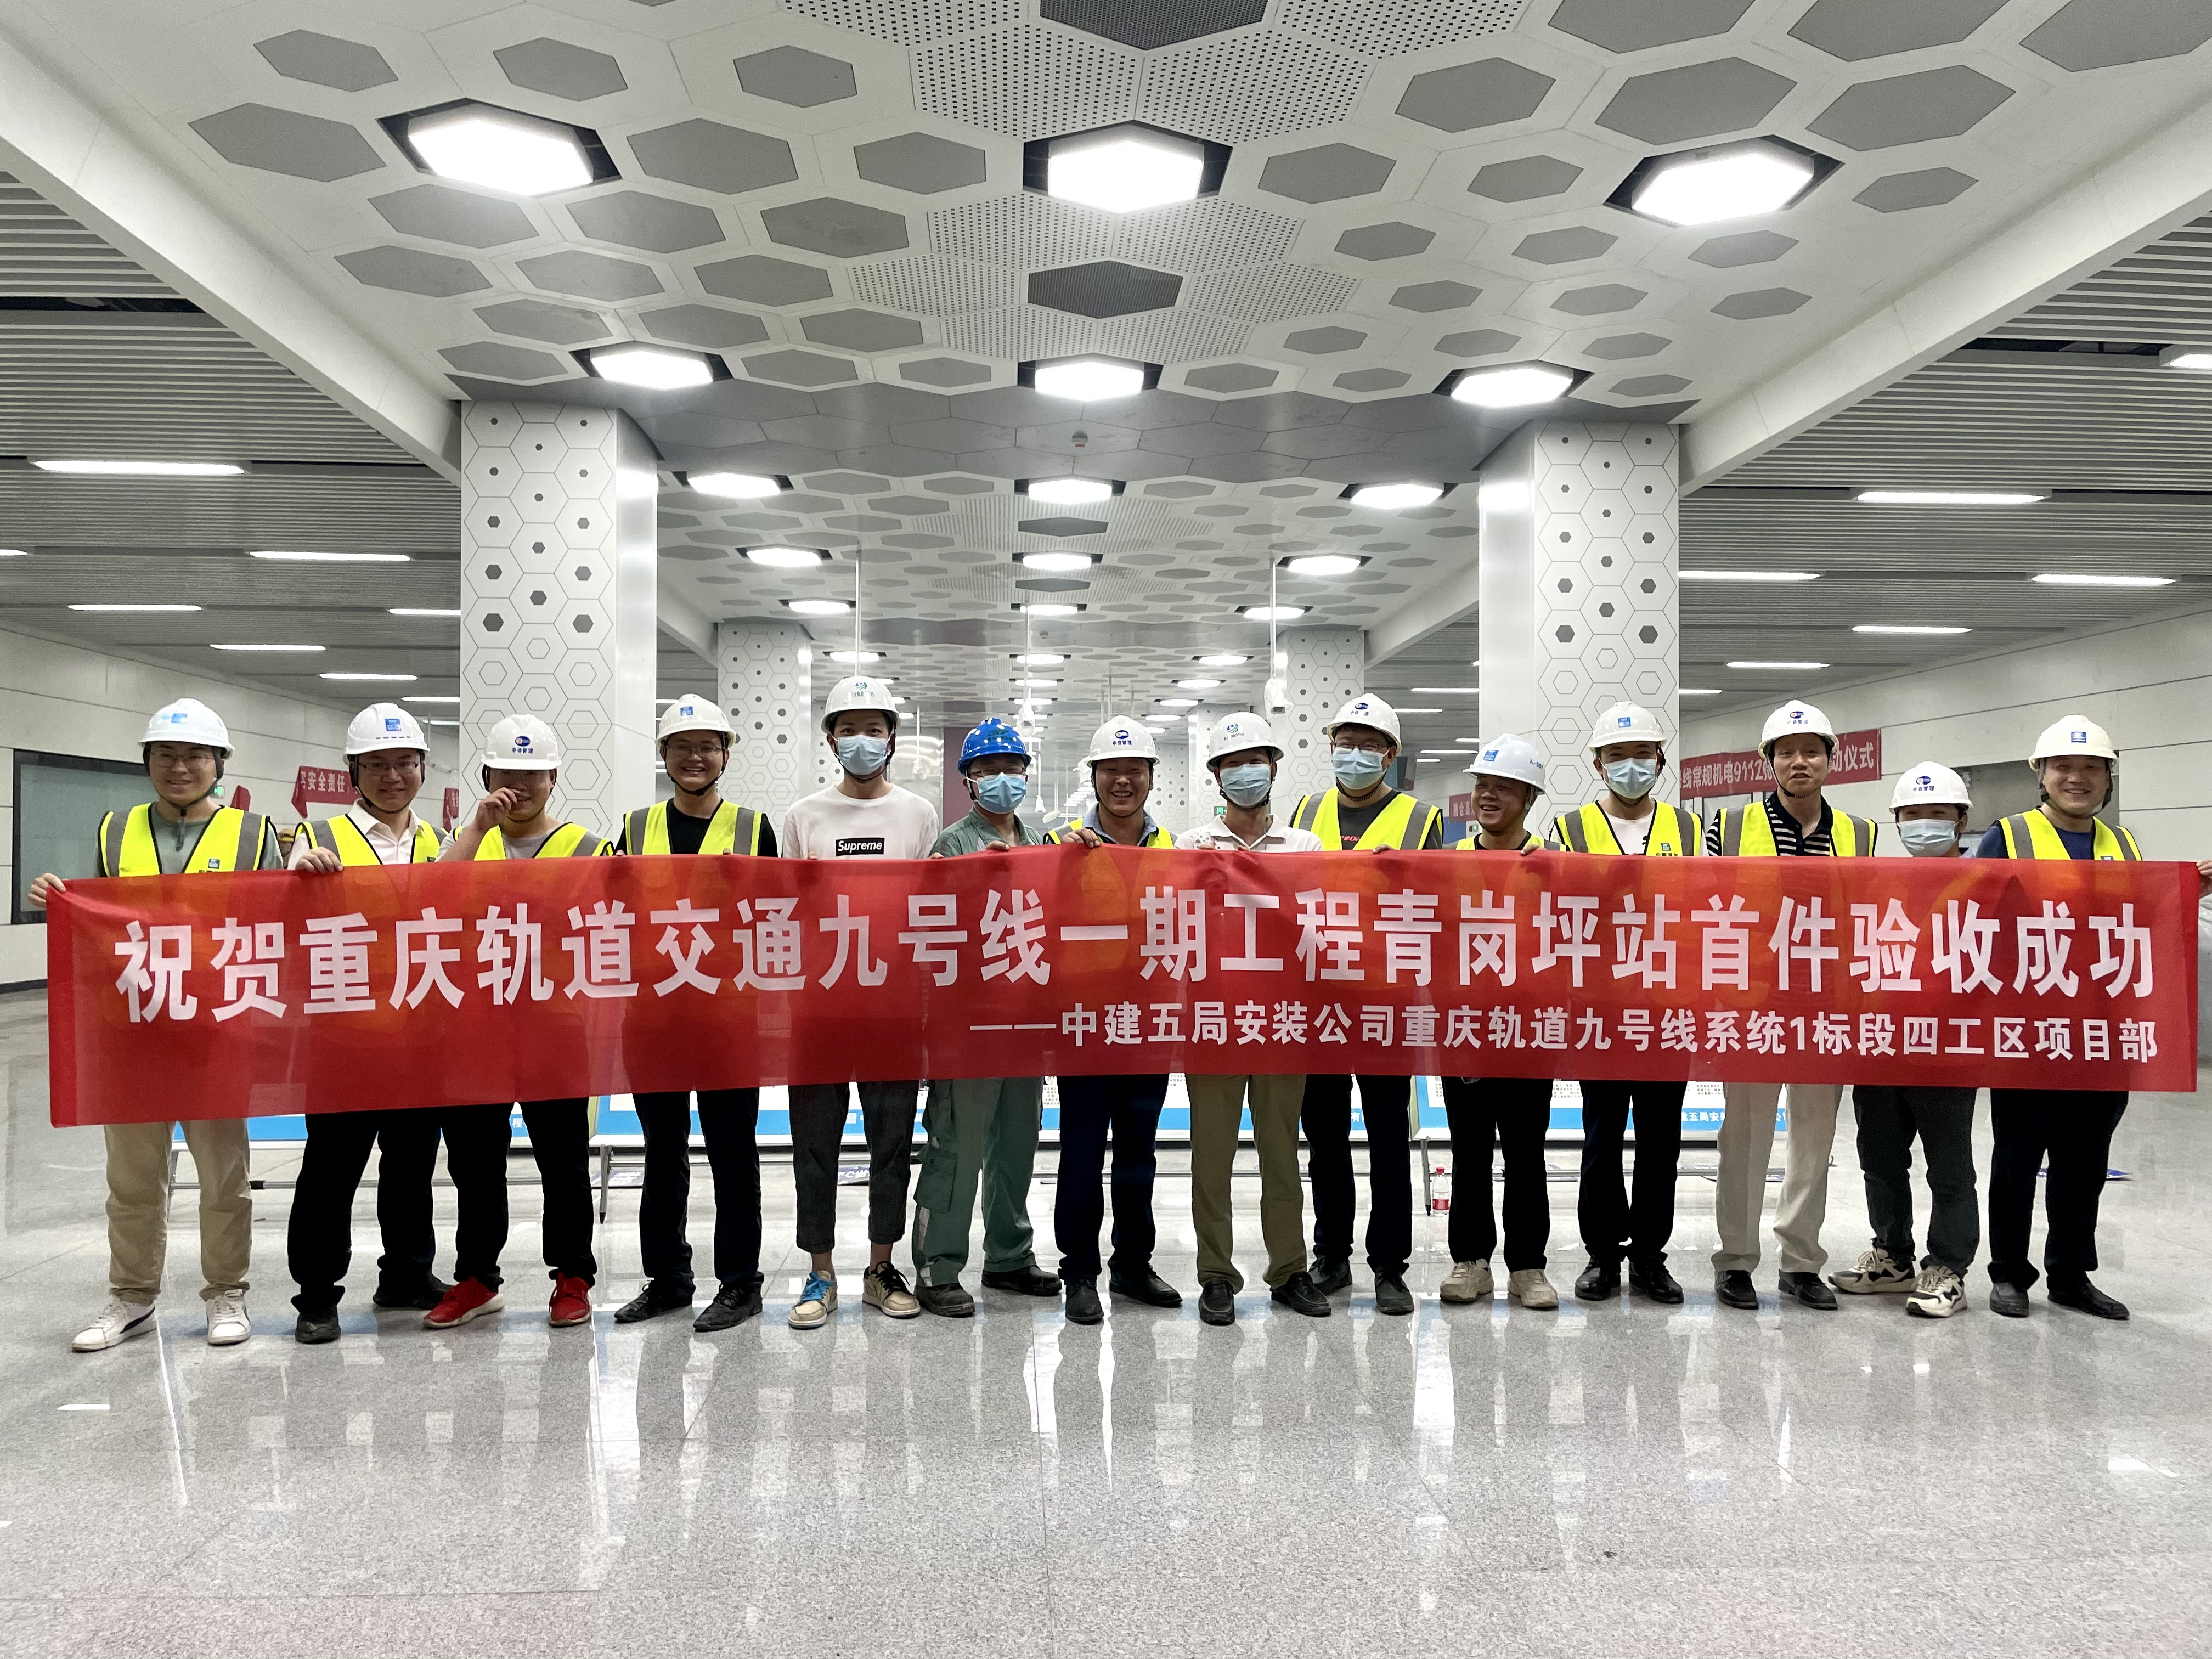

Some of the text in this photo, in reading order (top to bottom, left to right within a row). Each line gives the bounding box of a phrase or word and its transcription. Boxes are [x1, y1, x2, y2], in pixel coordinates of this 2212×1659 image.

[1680, 759, 1773, 788] 线常规机电9112
[1453, 801, 1475, 817] 融合高
[838, 840, 883, 854] Supreme
[115, 885, 2154, 1023] 祝贺重庆轨道交通九号线一期工程青岗坪站首件验收成功
